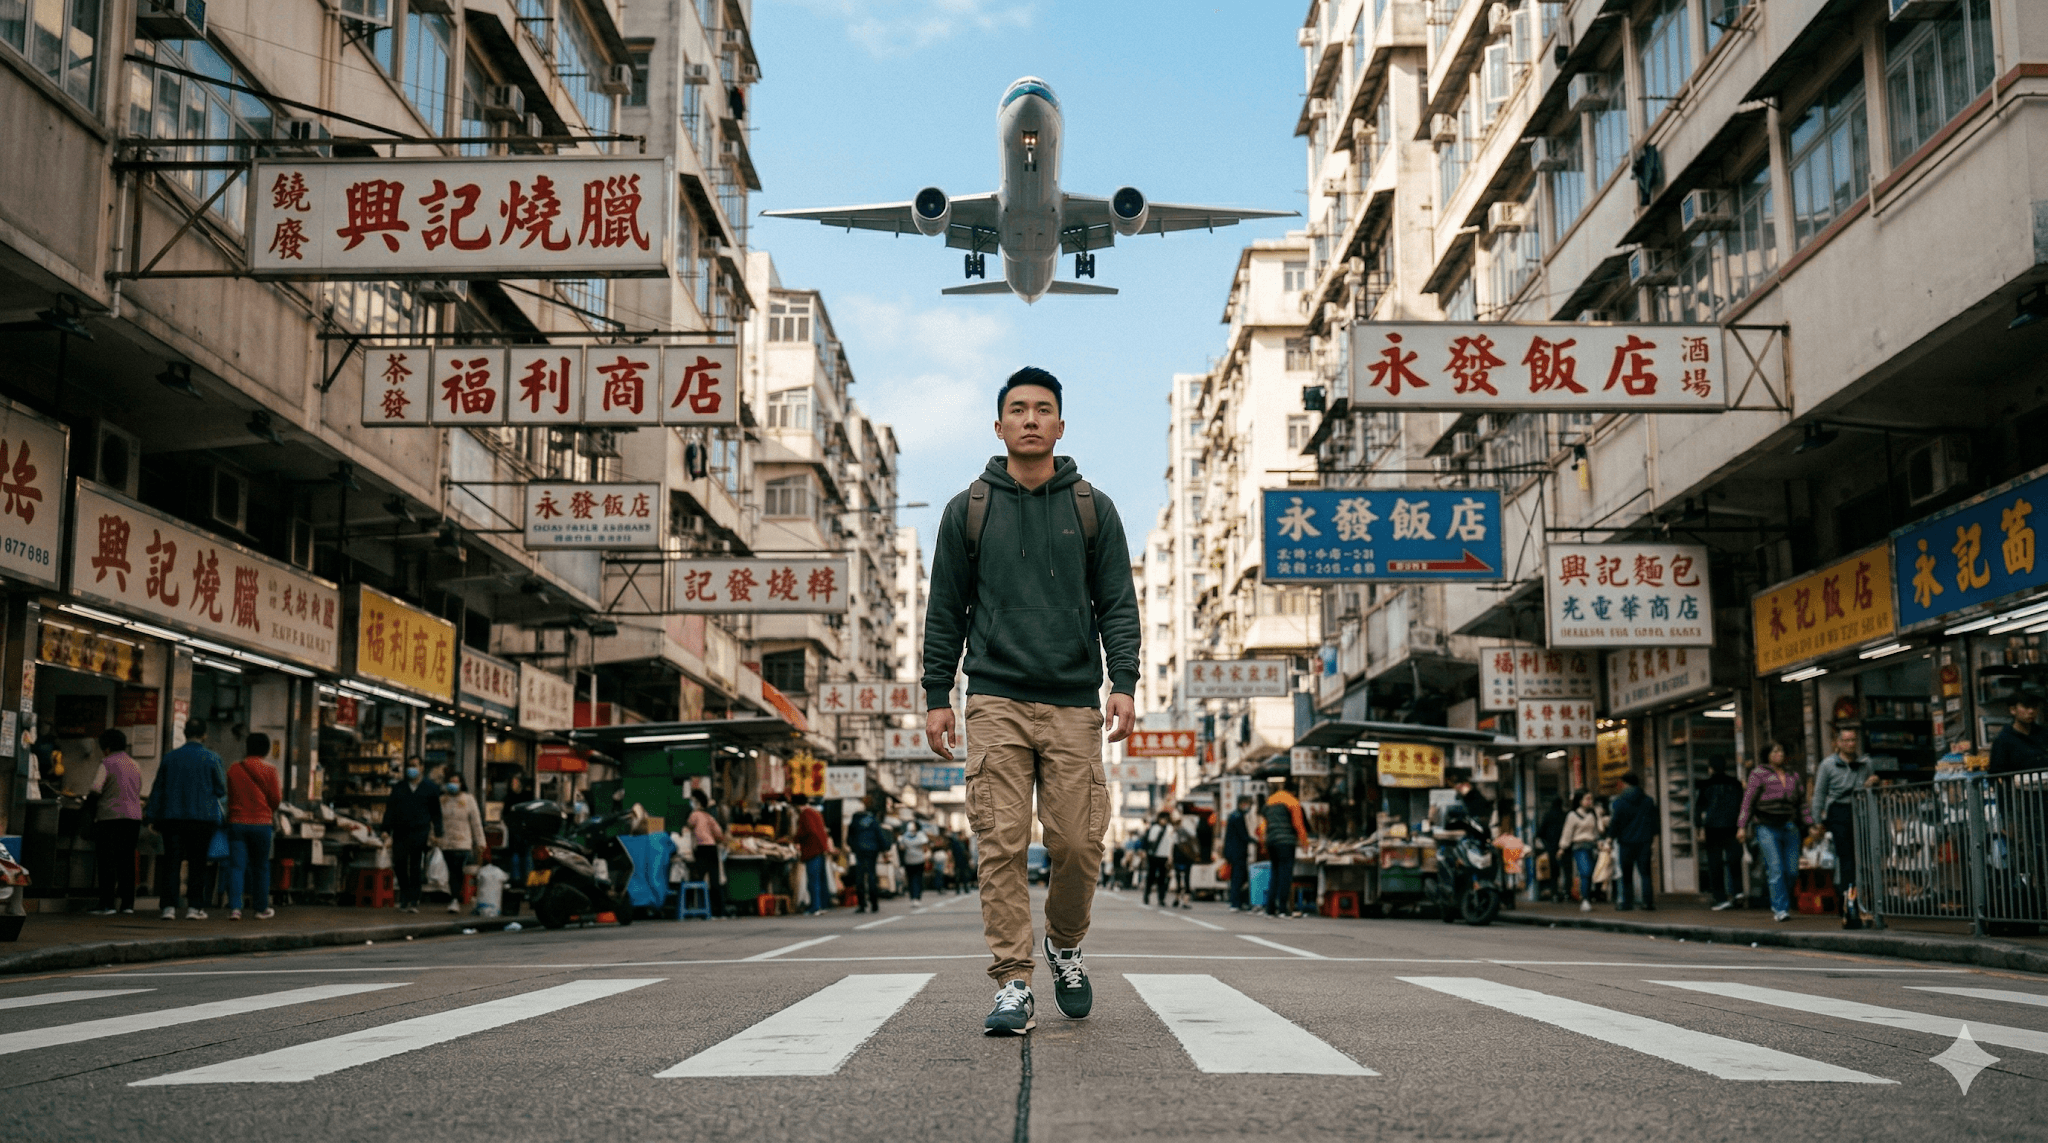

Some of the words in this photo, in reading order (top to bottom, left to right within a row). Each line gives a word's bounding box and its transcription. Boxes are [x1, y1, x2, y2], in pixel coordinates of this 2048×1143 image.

[336, 173, 651, 253] 興記燒臘
[441, 355, 723, 415] 福利商店
[1367, 332, 1658, 397] 永發飯店
[534, 489, 651, 520] 永發飯店
[1276, 497, 1487, 542] 永發飯店
[1558, 553, 1701, 588] 興記麵包
[366, 608, 447, 685] 福利商店
